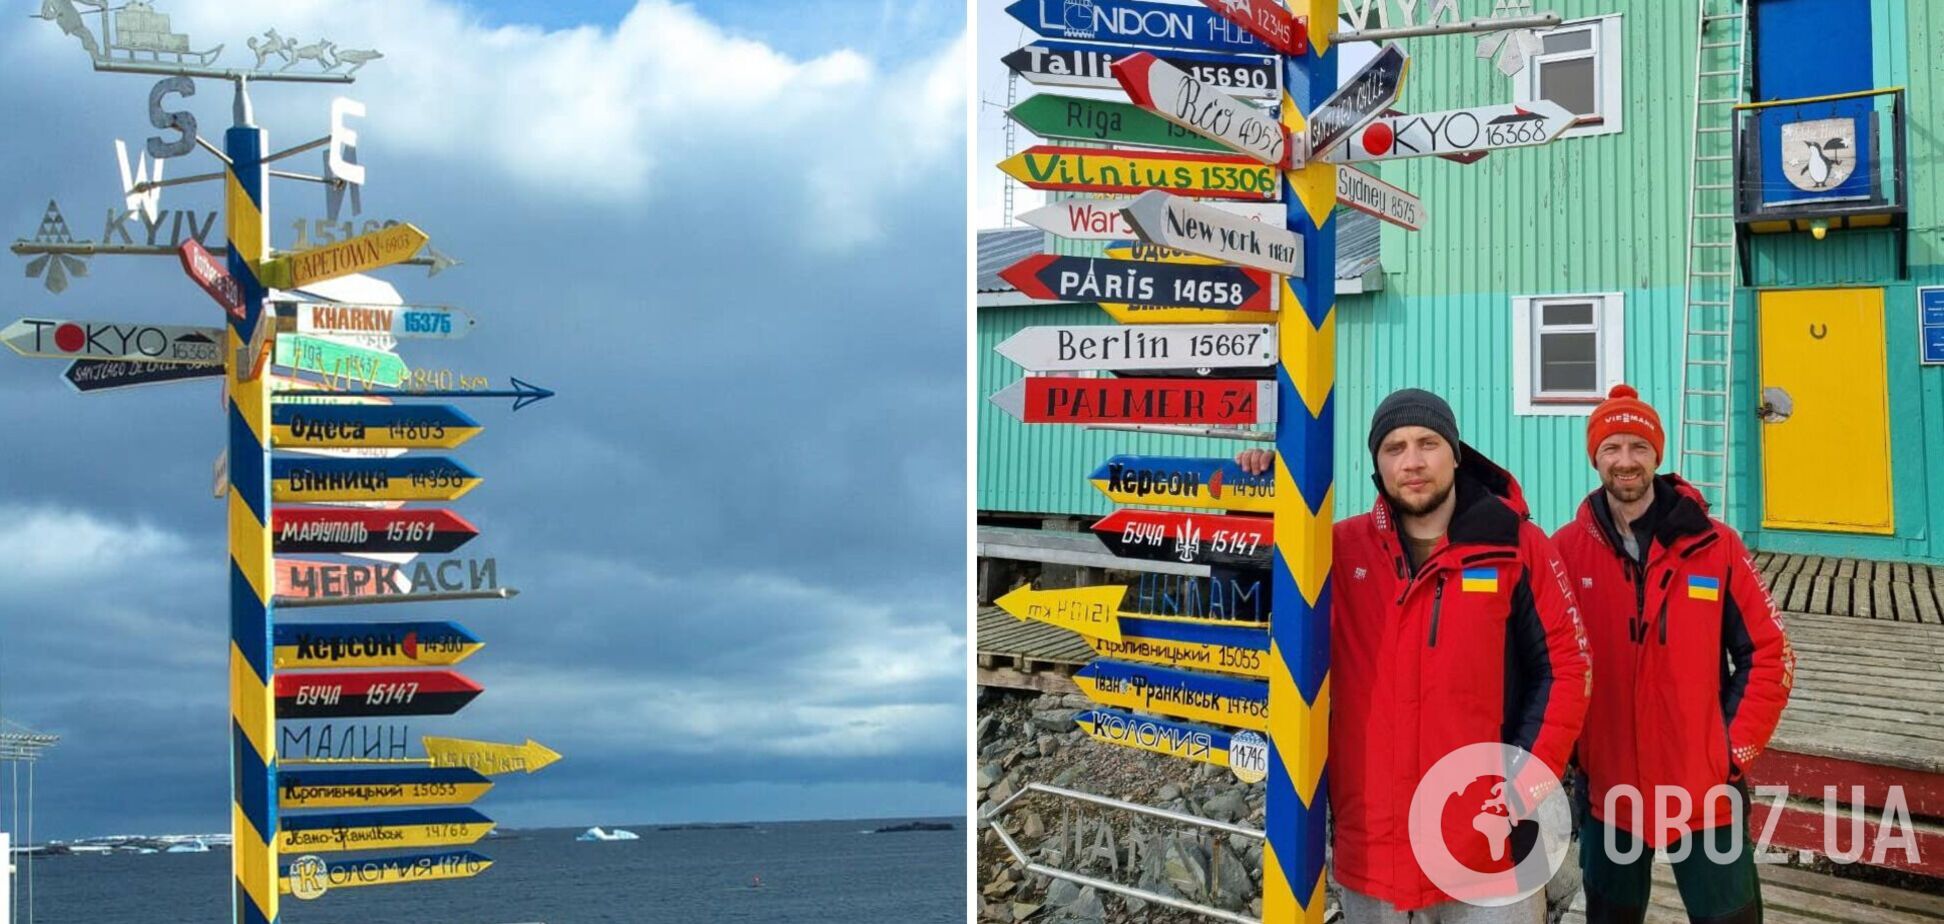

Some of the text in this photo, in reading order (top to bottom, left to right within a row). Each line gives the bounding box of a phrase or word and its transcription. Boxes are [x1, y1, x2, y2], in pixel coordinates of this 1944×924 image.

[1257, 7, 1291, 45] 12345
[1190, 66, 1268, 90] 15690
[147, 76, 197, 159] S
[1067, 101, 1122, 138] Riga
[1176, 75, 1234, 137] Rio
[328, 97, 366, 185] E
[1485, 119, 1547, 147] 16368
[115, 139, 164, 225] W
[1022, 153, 1276, 193] Vilnius 15306
[1338, 168, 1416, 226] Sydney 8575
[103, 208, 218, 246] KYIV
[1166, 206, 1215, 243] New
[1173, 278, 1244, 306] 14658
[312, 306, 452, 333] KHARKIV 15375
[23, 320, 167, 356] TOKYO
[1057, 329, 1261, 361] Berlin 15667
[1046, 387, 1205, 419] PALMER
[291, 413, 445, 441] Одеса 14803
[289, 467, 390, 493] Вінниця
[1107, 463, 1200, 498] Херсон
[386, 521, 436, 542] 15161
[1121, 521, 1262, 557] БУЧА 15147
[290, 557, 498, 598] ЧЕРКАСИ
[296, 633, 397, 662] Херсон
[1218, 645, 1261, 670] 15053
[296, 682, 419, 706] БУЧА 15147
[1227, 696, 1270, 719] 14768
[281, 725, 409, 759] МАЛИН
[1091, 711, 1267, 772] КОЛОМИЯ 14746
[285, 783, 457, 803] Кропивницький 15053
[425, 824, 469, 838] 14768
